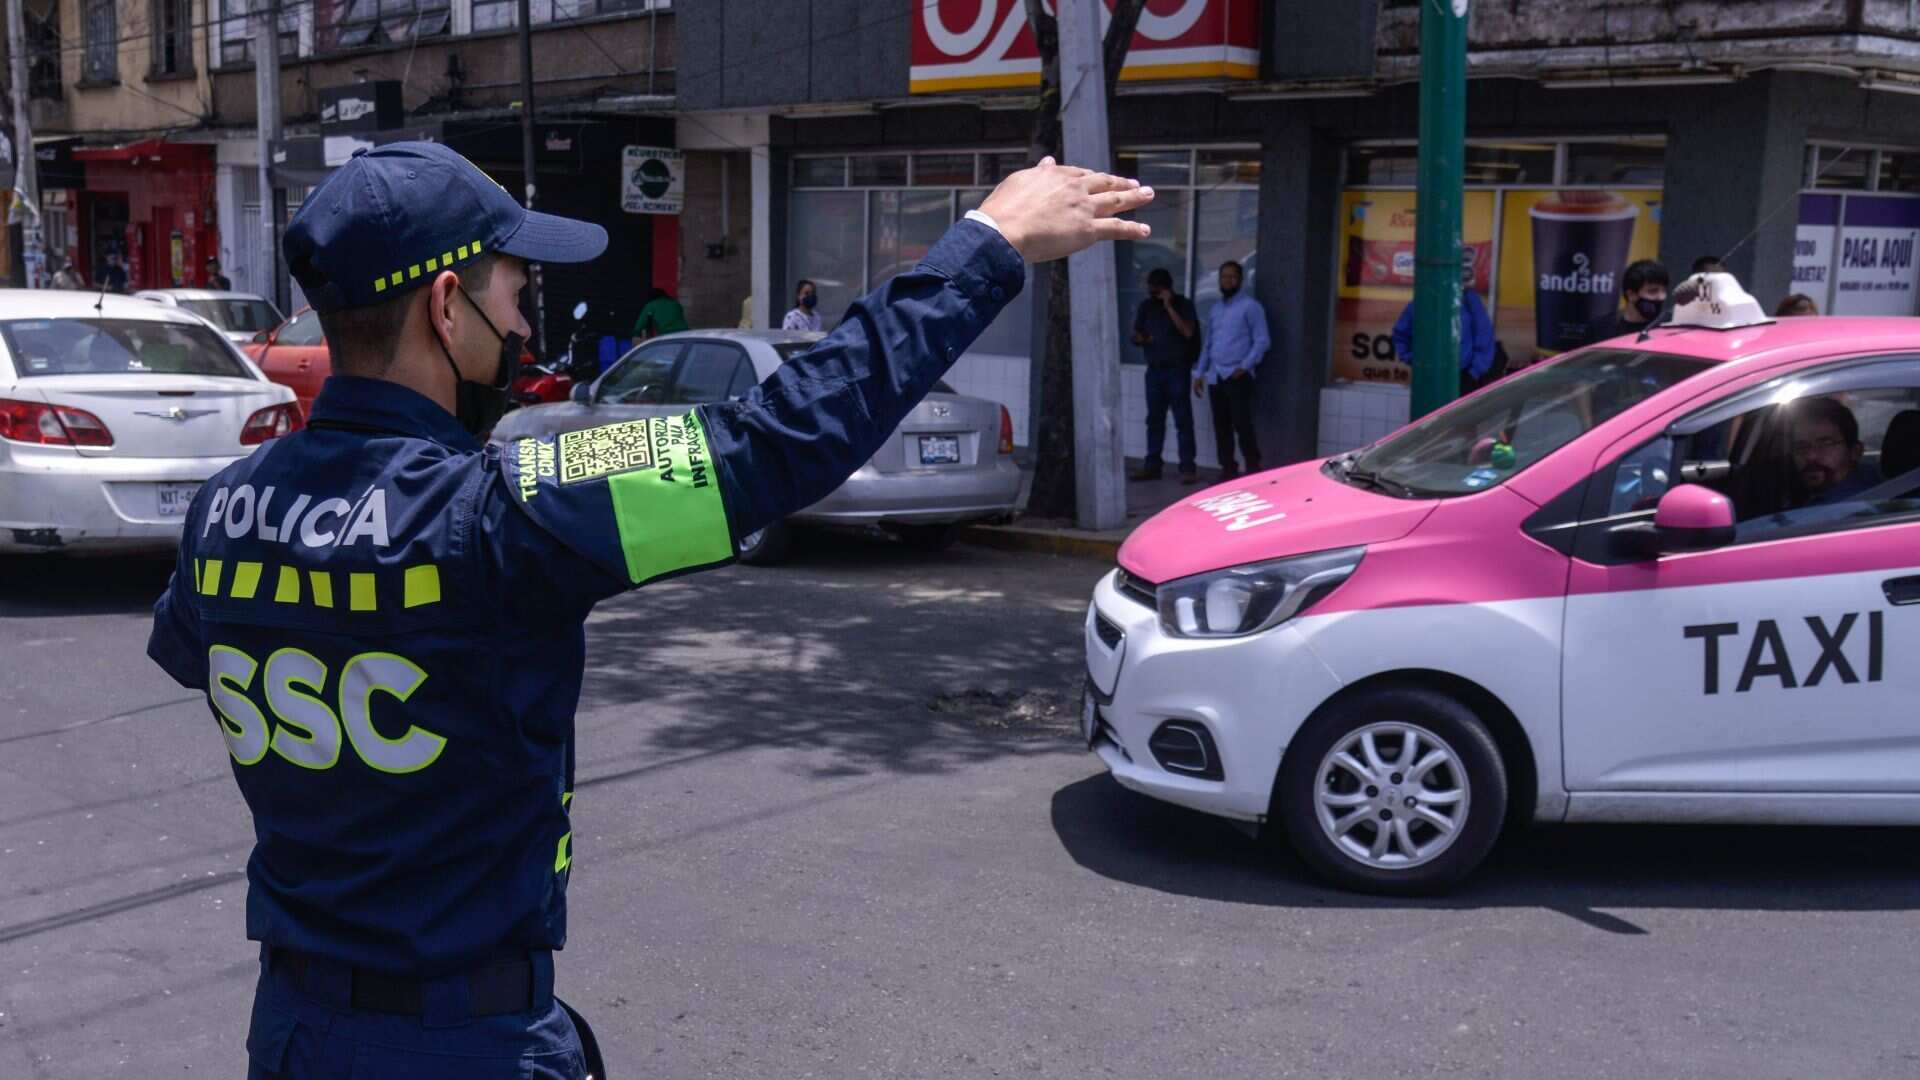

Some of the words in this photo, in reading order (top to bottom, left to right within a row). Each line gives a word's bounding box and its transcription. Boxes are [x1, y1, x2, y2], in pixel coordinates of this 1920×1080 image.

[1842, 237, 1877, 268] PAGA
[1881, 231, 1916, 276] AQUÍ
[1540, 271, 1614, 293] andatti
[1362, 367, 1391, 381] que
[537, 440, 556, 477] CDMX
[202, 484, 390, 548] POLICÍA
[1683, 610, 1884, 695] TAXI
[209, 644, 448, 774] SSC
